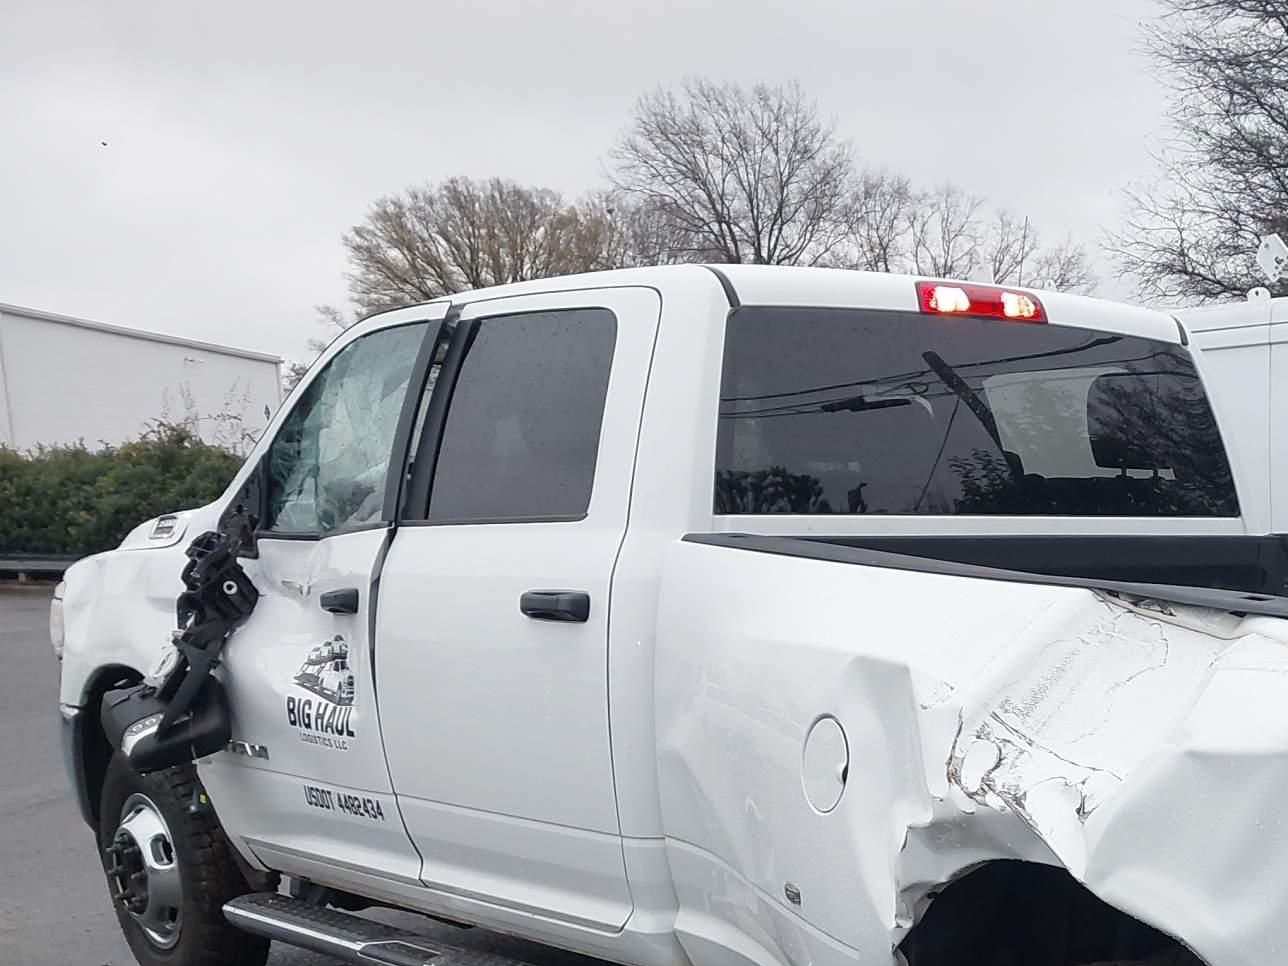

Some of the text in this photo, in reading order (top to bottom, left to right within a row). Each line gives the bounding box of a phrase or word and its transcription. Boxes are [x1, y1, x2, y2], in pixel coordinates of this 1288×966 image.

[287, 696, 355, 738] BIG HAUL
[300, 731, 348, 750] LOGISTICS LLC
[304, 784, 385, 821] USDOT 4482434
